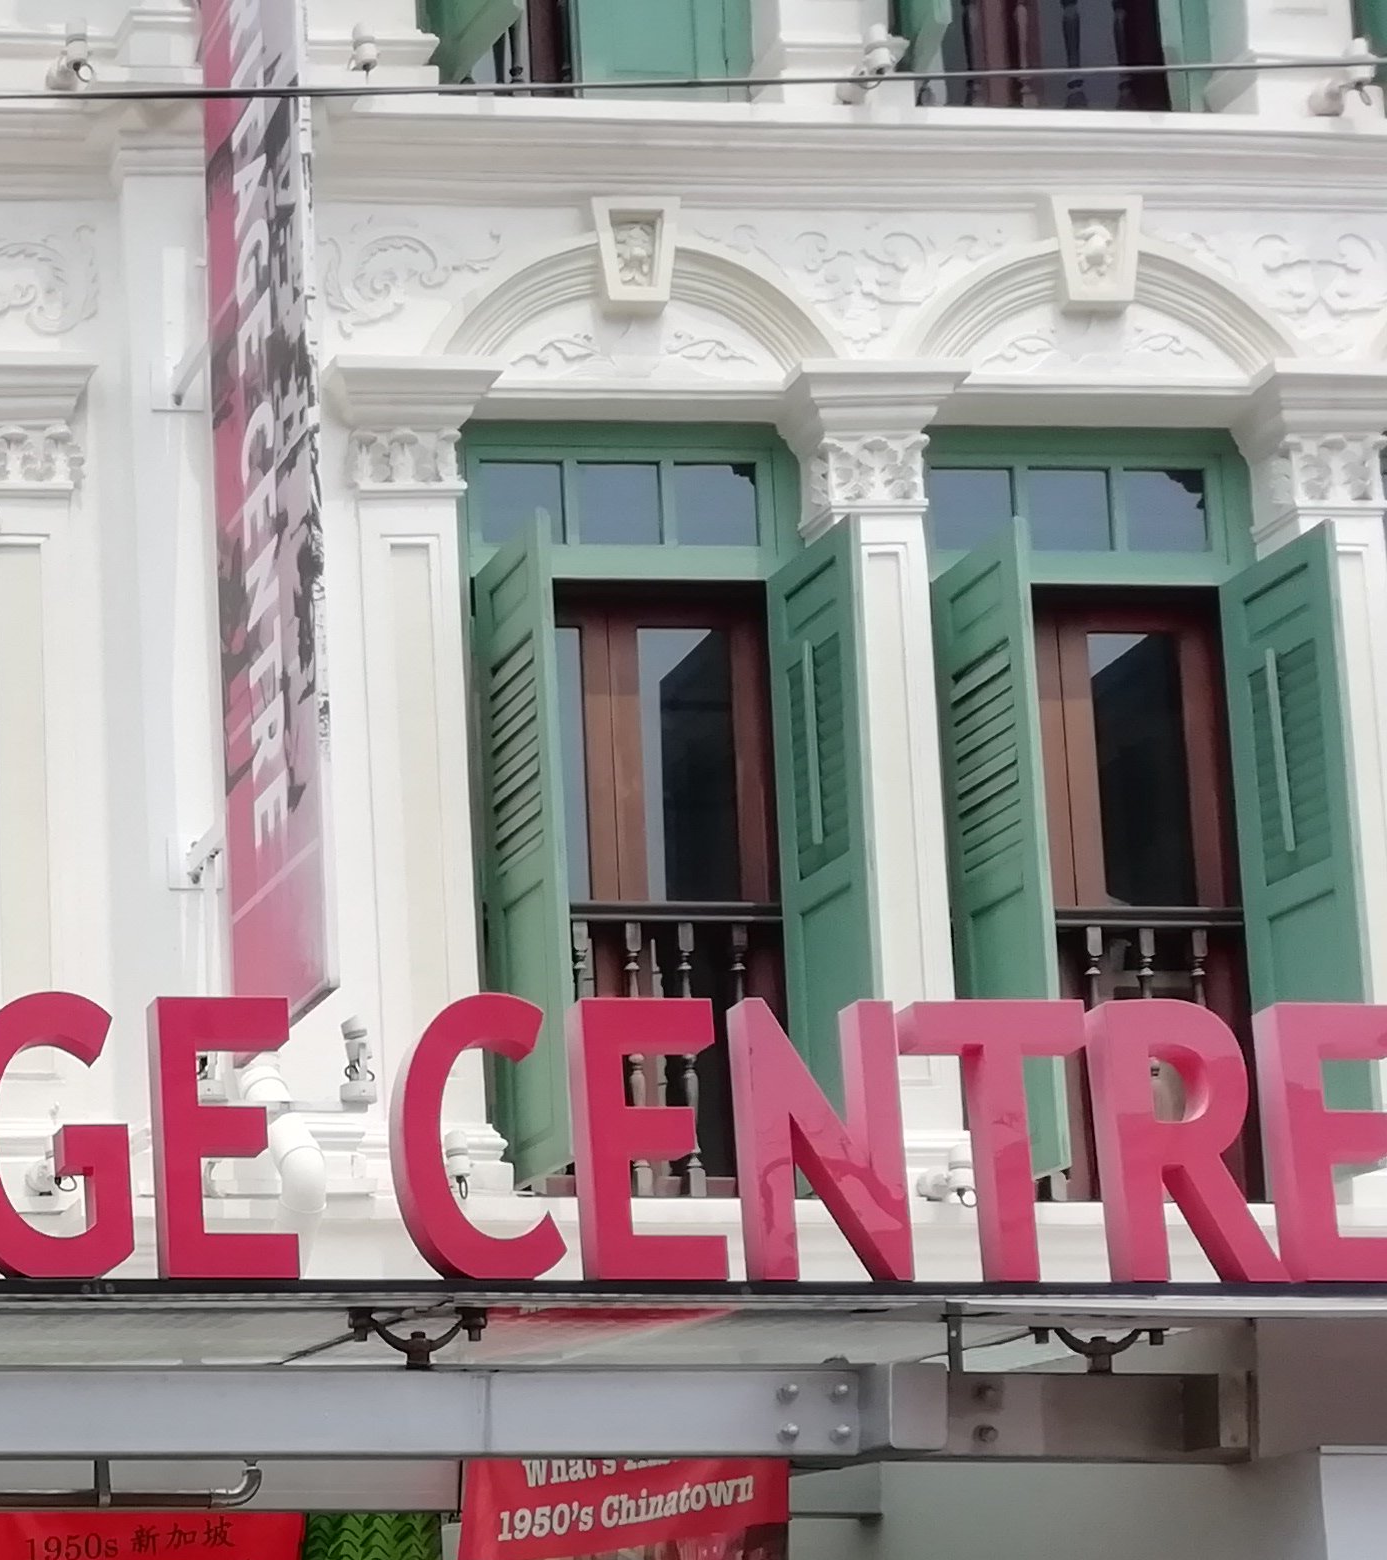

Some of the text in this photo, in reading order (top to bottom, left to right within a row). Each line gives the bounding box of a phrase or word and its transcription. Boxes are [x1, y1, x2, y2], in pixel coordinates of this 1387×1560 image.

[240, 401, 289, 848] CENTRE
[390, 992, 1387, 1282] CENTRE
[130, 1515, 235, 1555] 新加坡
[497, 1475, 754, 1542] 1950's Chinatown
